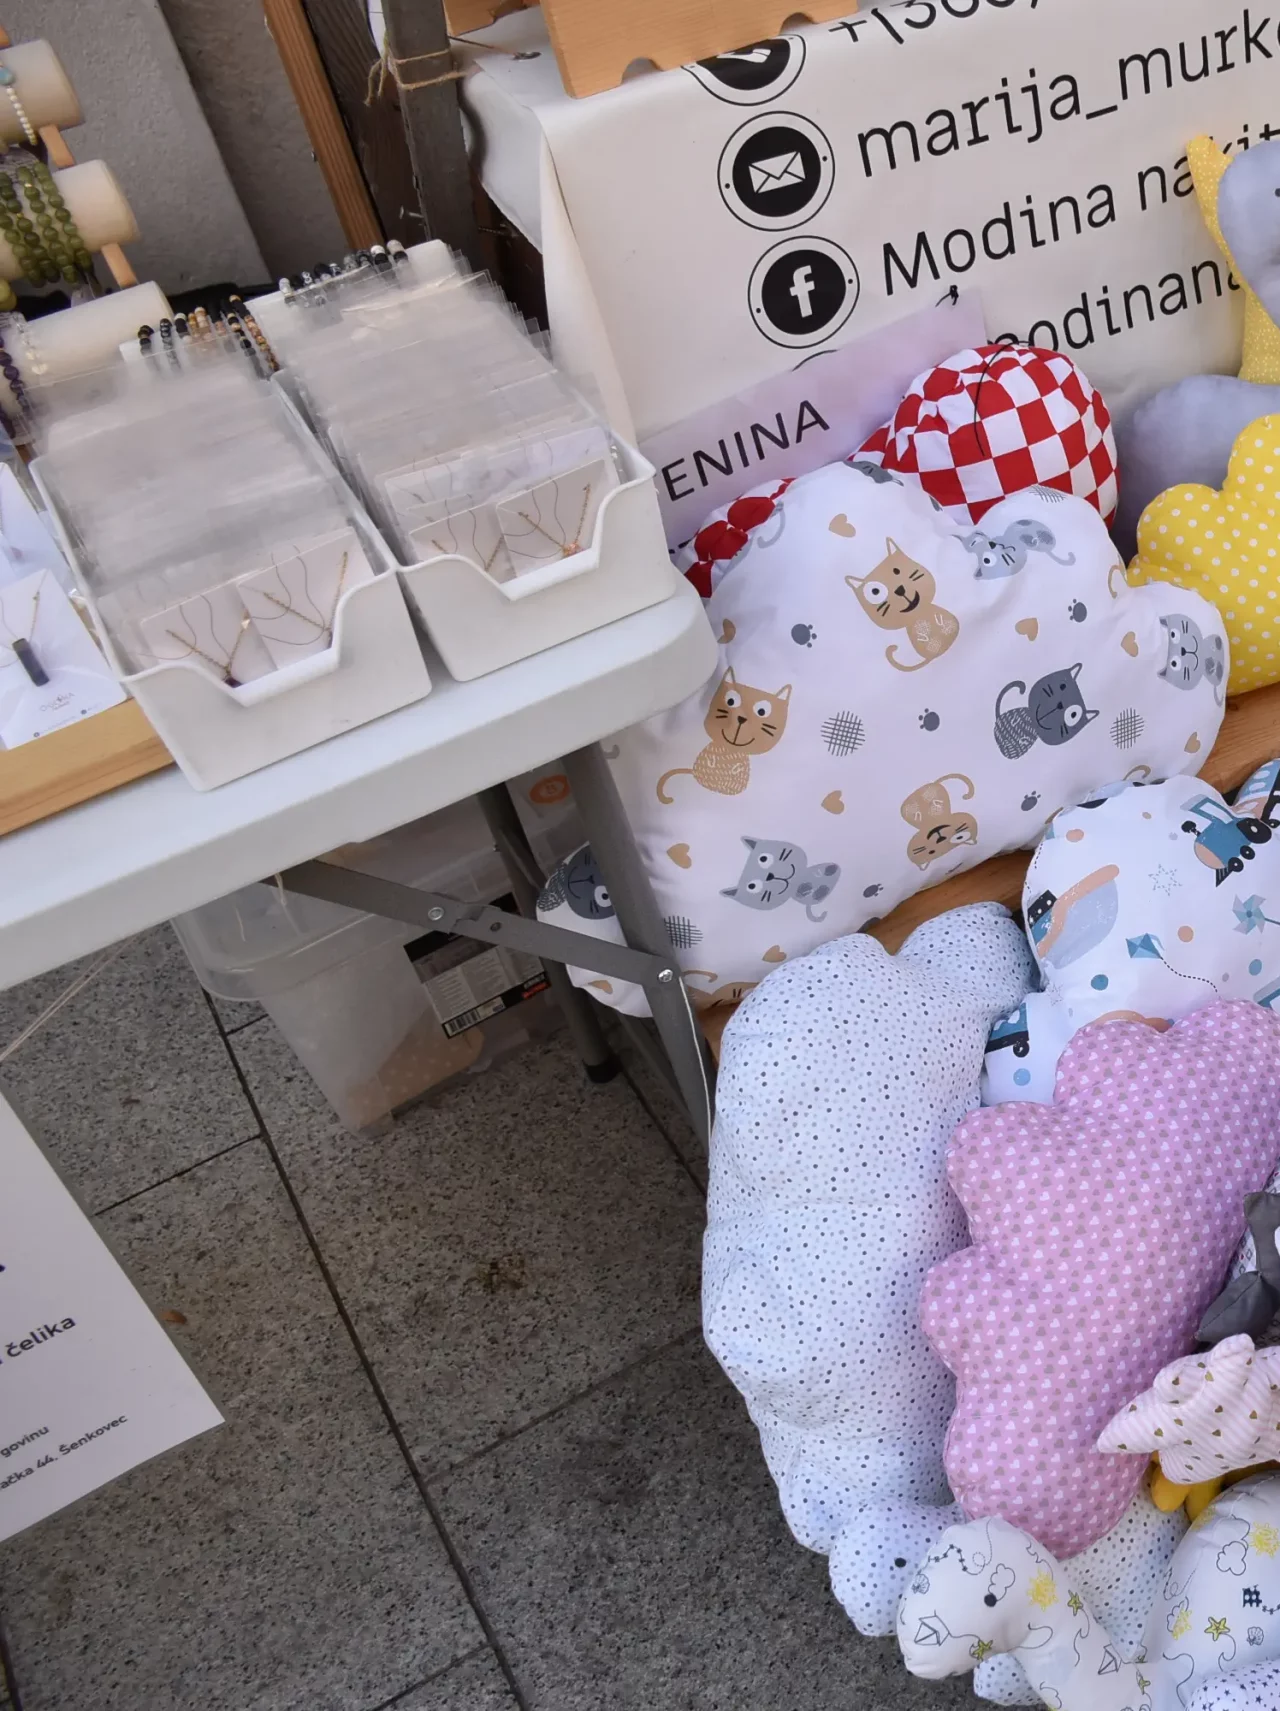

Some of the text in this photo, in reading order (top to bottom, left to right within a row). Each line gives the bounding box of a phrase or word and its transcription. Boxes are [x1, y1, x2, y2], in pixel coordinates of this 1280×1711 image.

[882, 183, 1117, 295] Modina
[5, 1316, 77, 1359] čelika
[59, 1415, 128, 1456] Šenkovec
